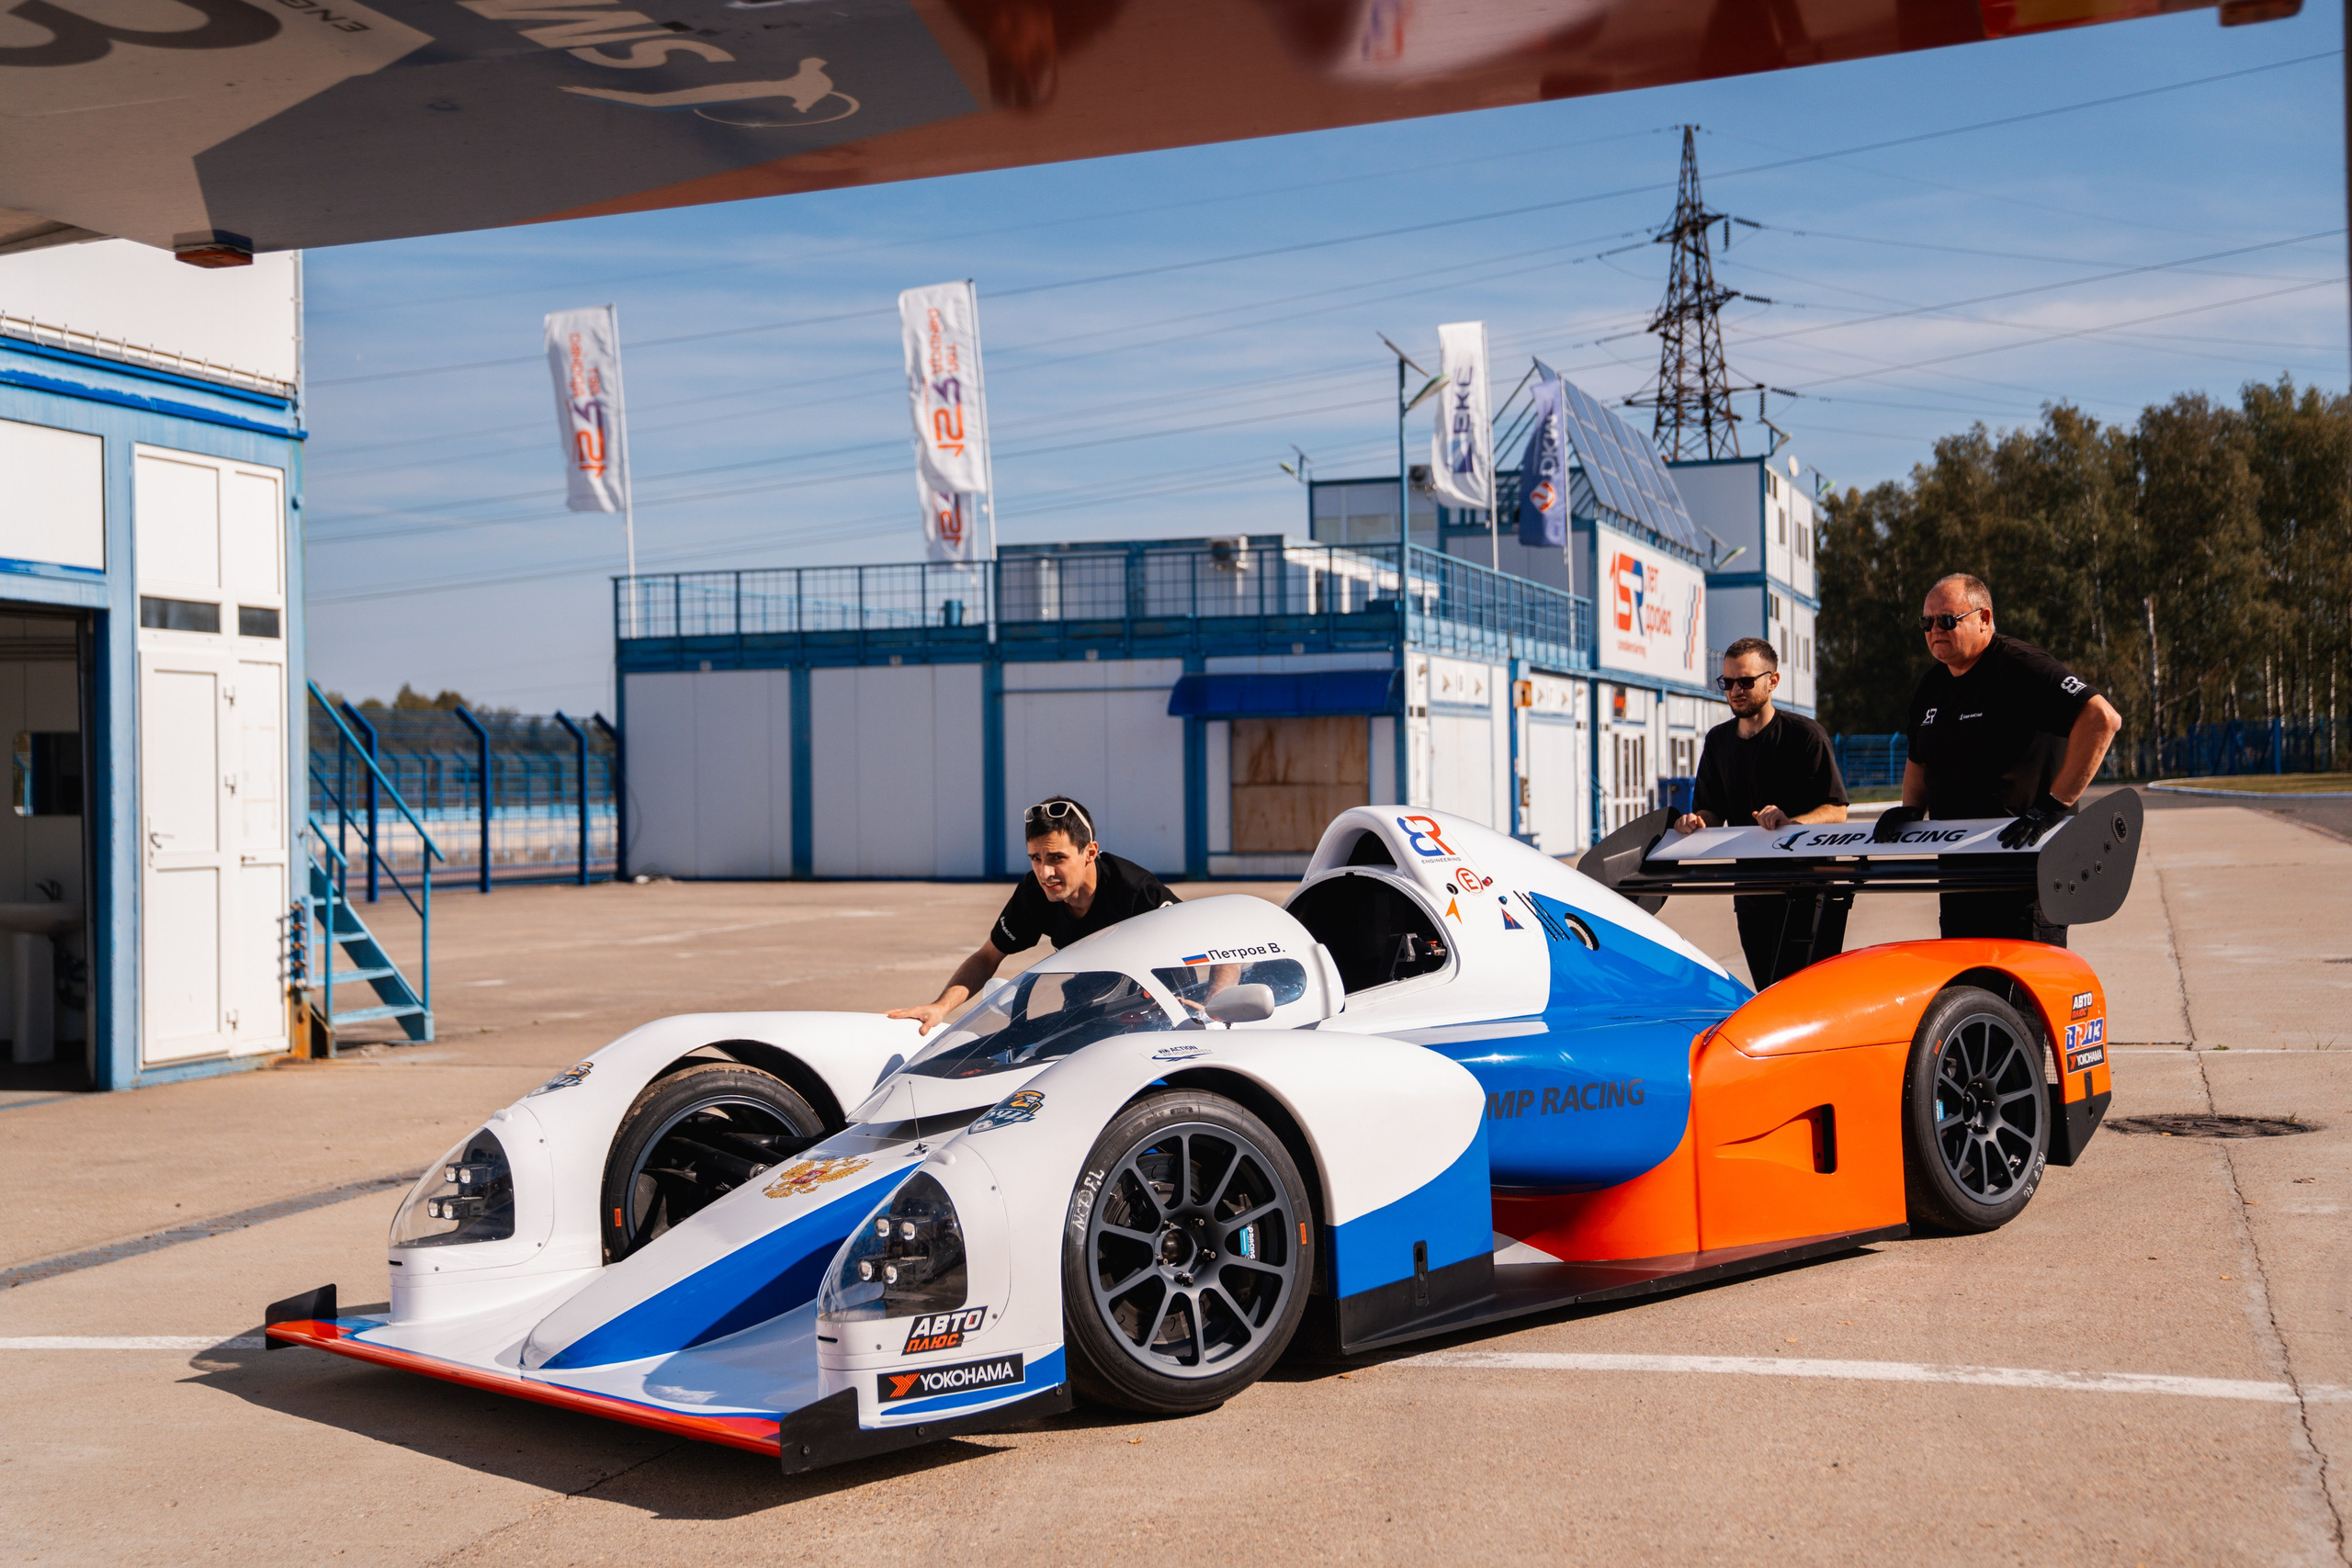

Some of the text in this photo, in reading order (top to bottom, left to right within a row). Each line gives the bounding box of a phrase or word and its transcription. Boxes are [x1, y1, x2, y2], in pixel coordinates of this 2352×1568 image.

[1805, 833, 1866, 846] SMP
[1207, 942, 1286, 960] Петров В.
[2072, 992, 2093, 1010] АВТО
[2076, 1049, 2102, 1066] YOKOHAMA
[1541, 1078, 1645, 1115] RACING
[911, 1309, 983, 1337] АВТО
[906, 1333, 959, 1353] ПЛЮС
[920, 1361, 1014, 1391] YOKOHAMA
